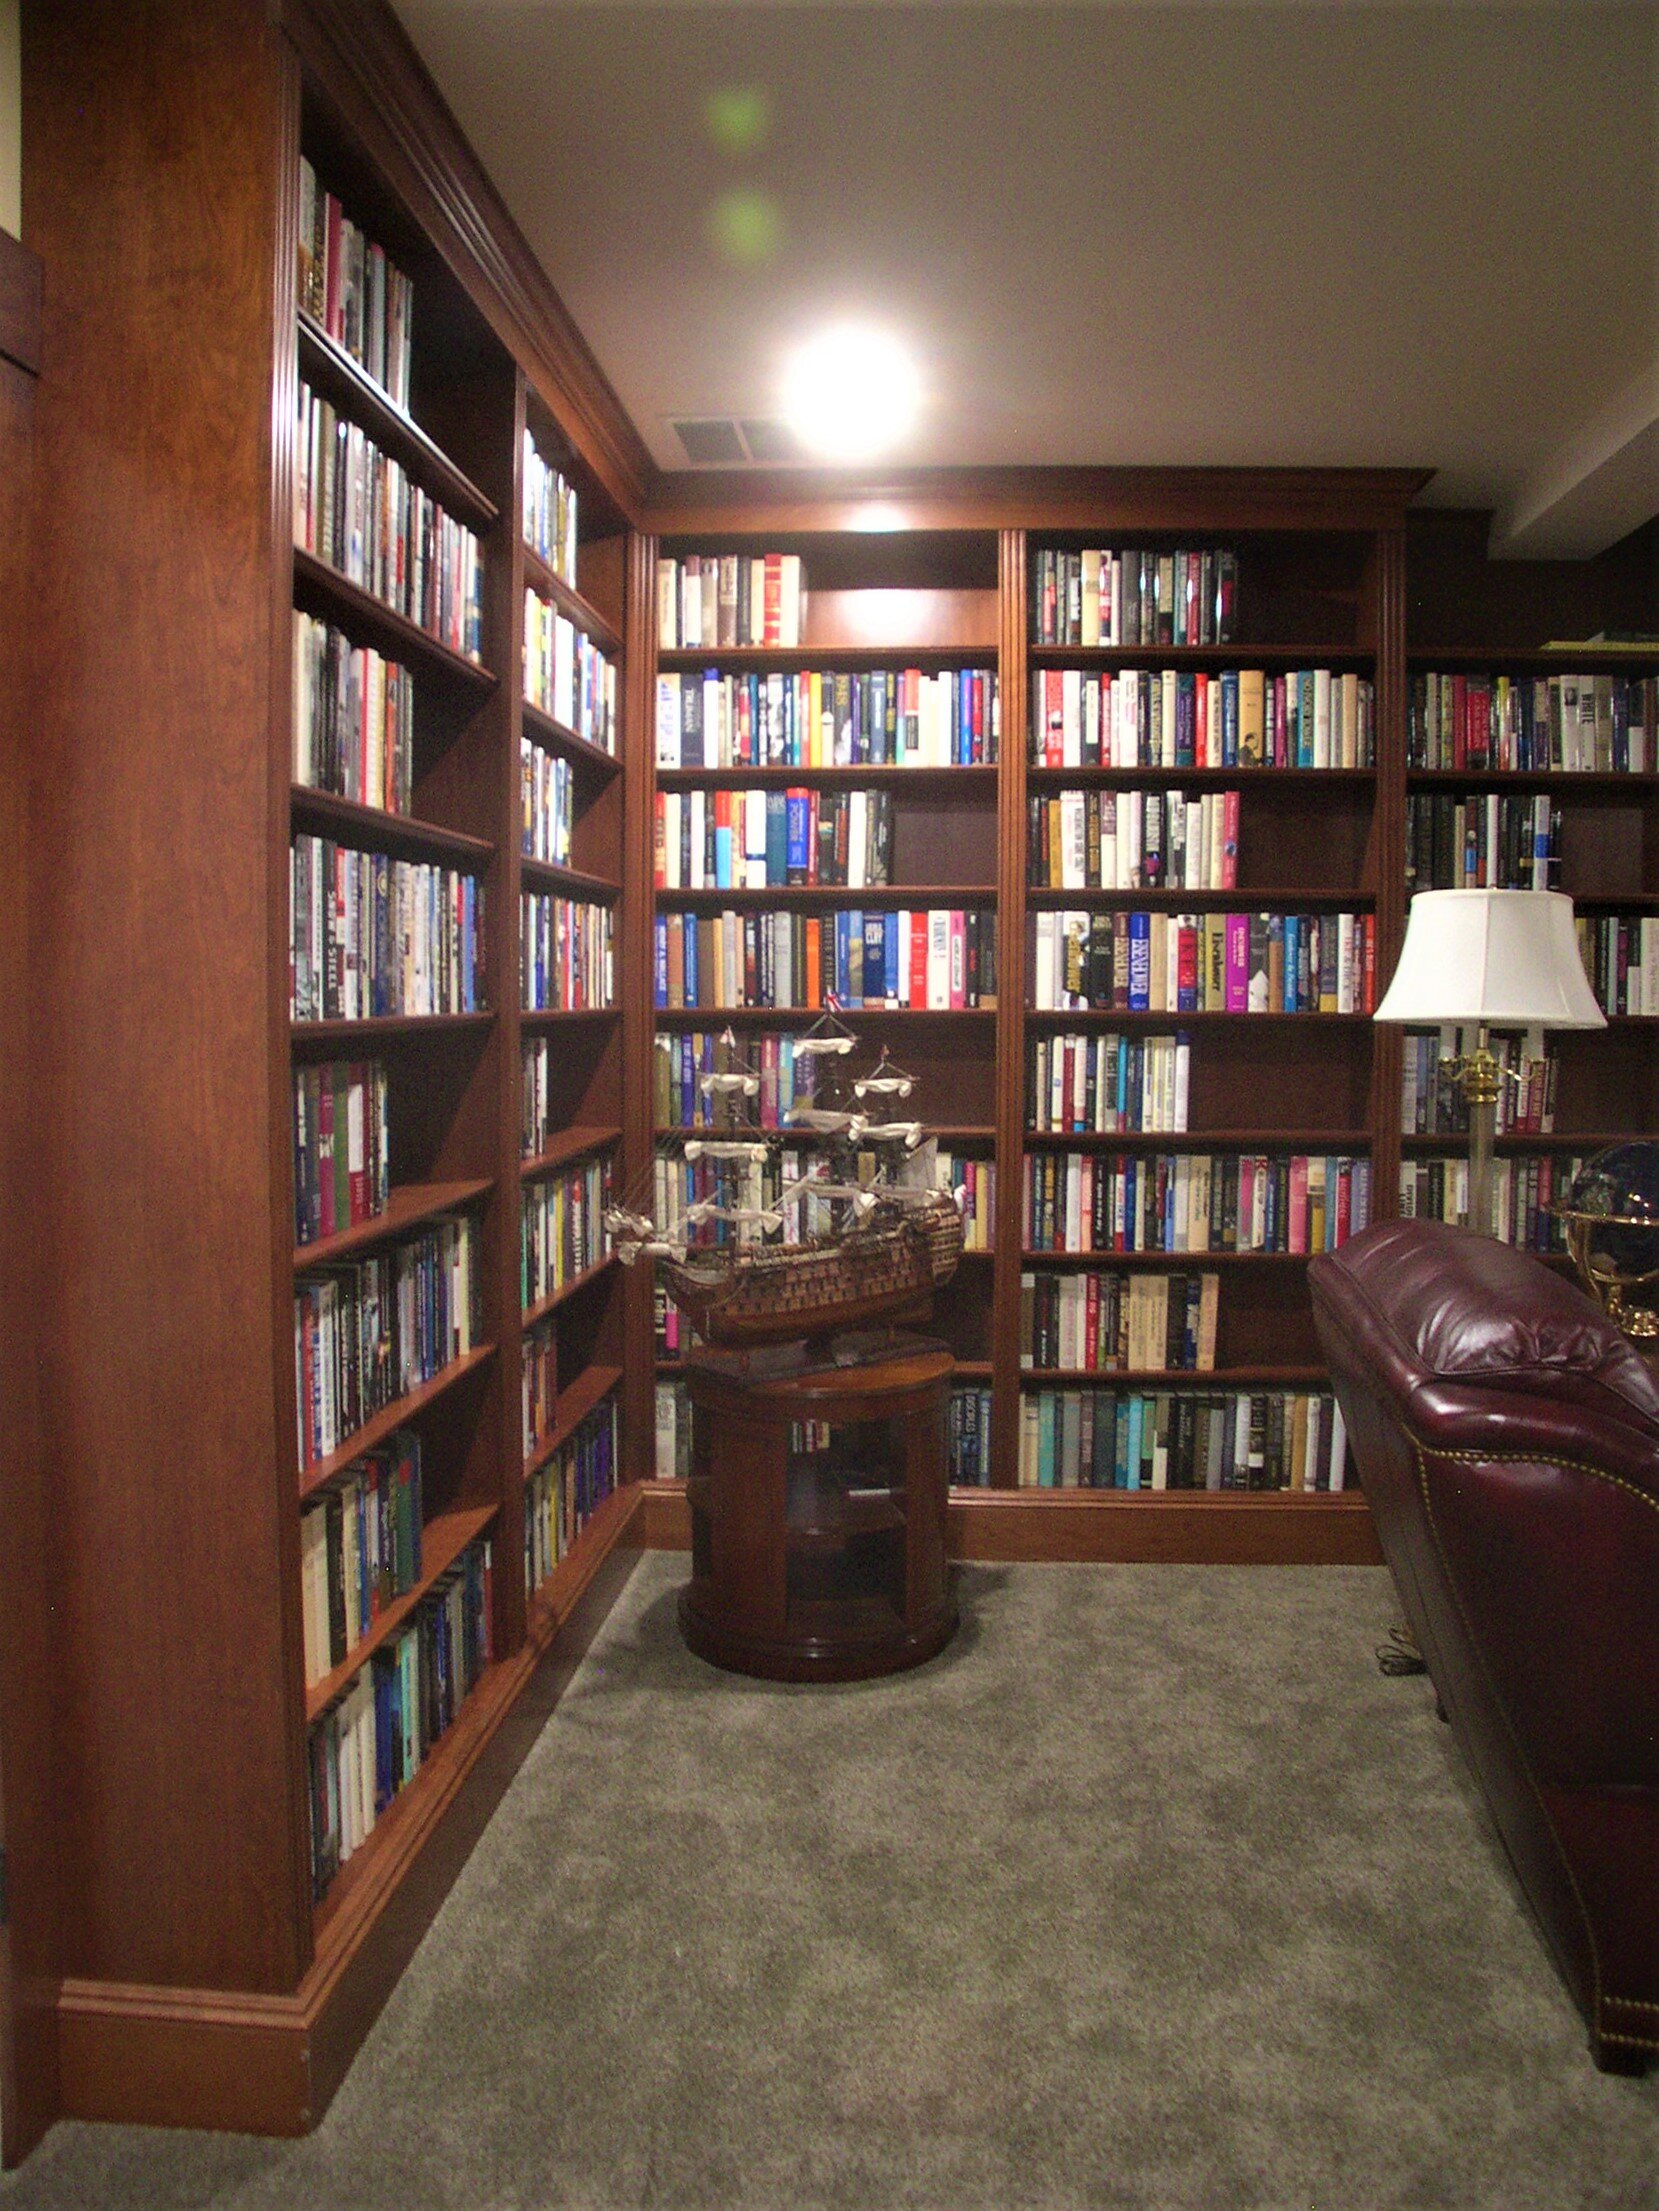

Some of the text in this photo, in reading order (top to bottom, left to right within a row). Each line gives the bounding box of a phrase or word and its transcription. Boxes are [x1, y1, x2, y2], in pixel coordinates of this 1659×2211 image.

[684, 688, 695, 733] TRUMAN
[835, 674, 849, 705] 1948
[1581, 693, 1595, 724] WHITE
[1130, 938, 1148, 996] EISENHOWER
[1212, 932, 1224, 991] Eisenhower
